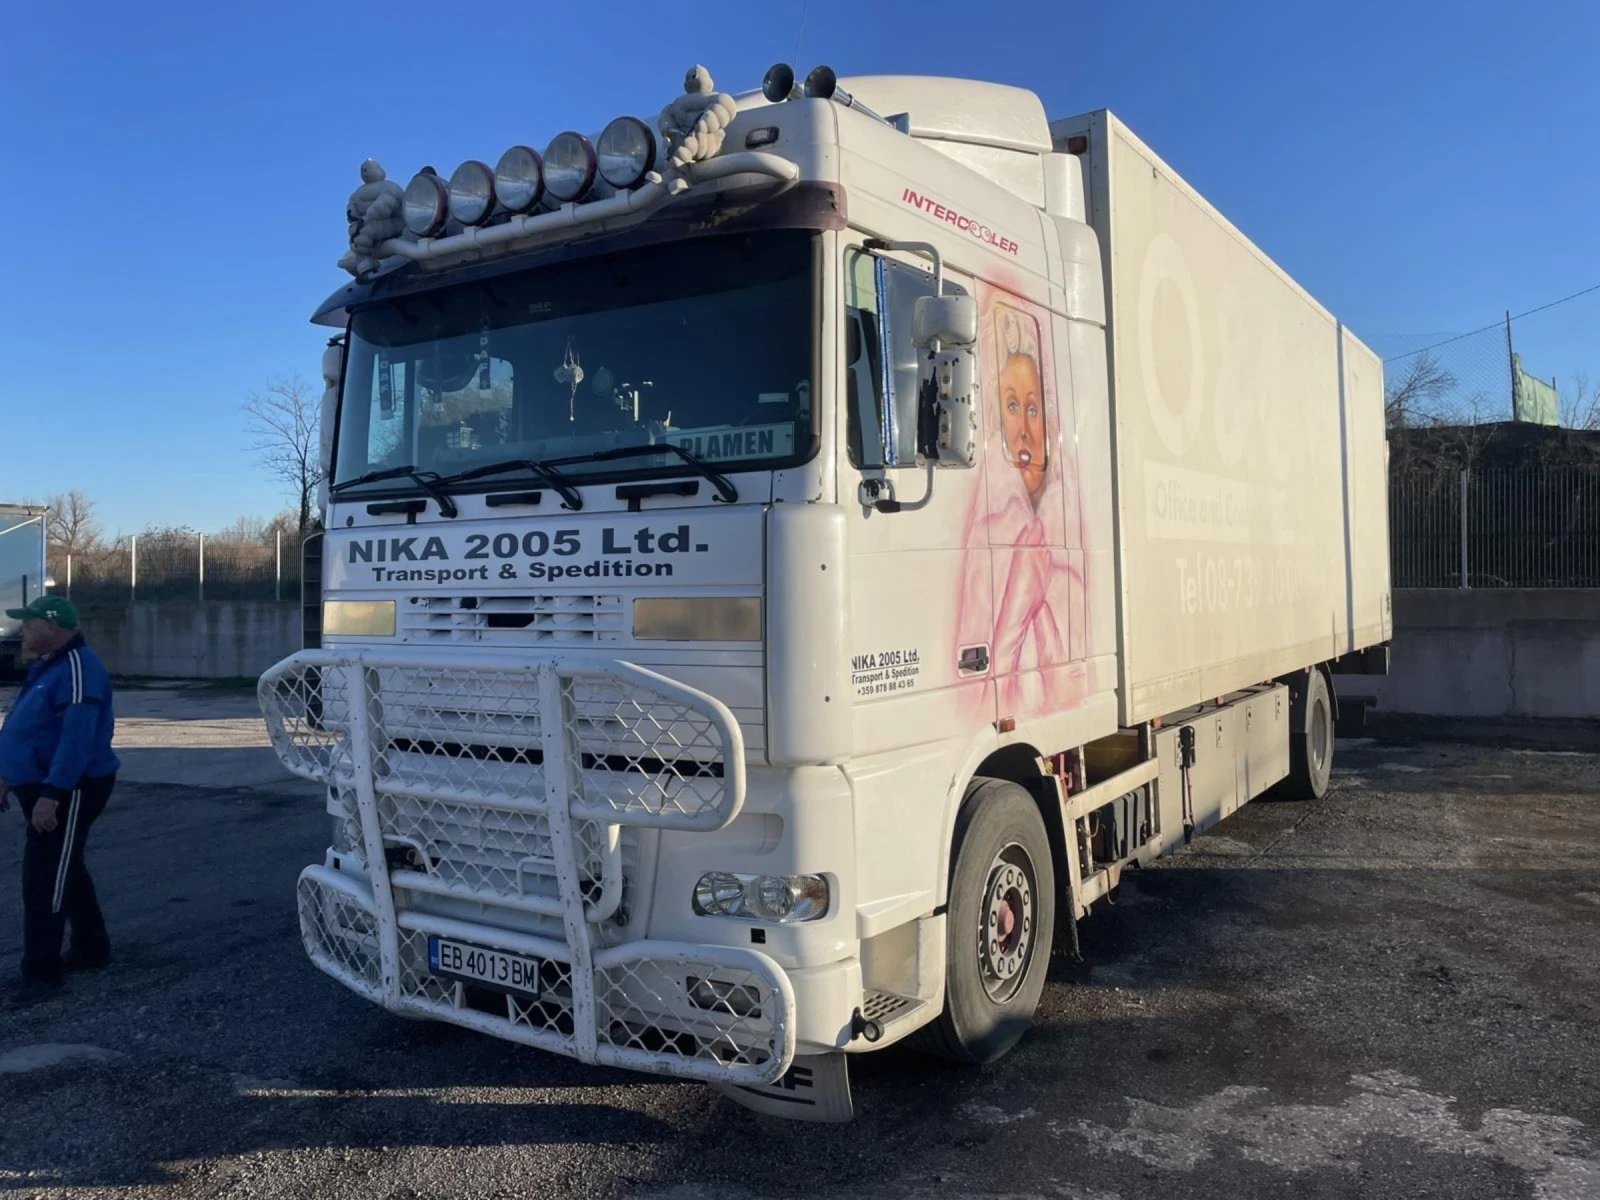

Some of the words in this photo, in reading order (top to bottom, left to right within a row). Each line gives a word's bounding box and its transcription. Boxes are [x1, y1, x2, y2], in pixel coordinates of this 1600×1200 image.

[902, 188, 1018, 255] INTERCOOLER
[679, 429, 774, 460] PLAMEN
[348, 536, 449, 564] NIKA
[464, 529, 581, 560] 2005
[601, 525, 709, 556] Ltd.
[371, 564, 489, 585] Transport
[498, 563, 518, 580] &
[529, 560, 674, 582] Spedition
[851, 654, 876, 670] NIKA
[879, 651, 900, 667] 2005
[903, 648, 920, 663] Ltd.
[851, 671, 883, 685] Transport
[885, 670, 890, 680] &
[892, 667, 919, 680] Spedition
[857, 686, 874, 695] +359
[898, 680, 905, 689] 43
